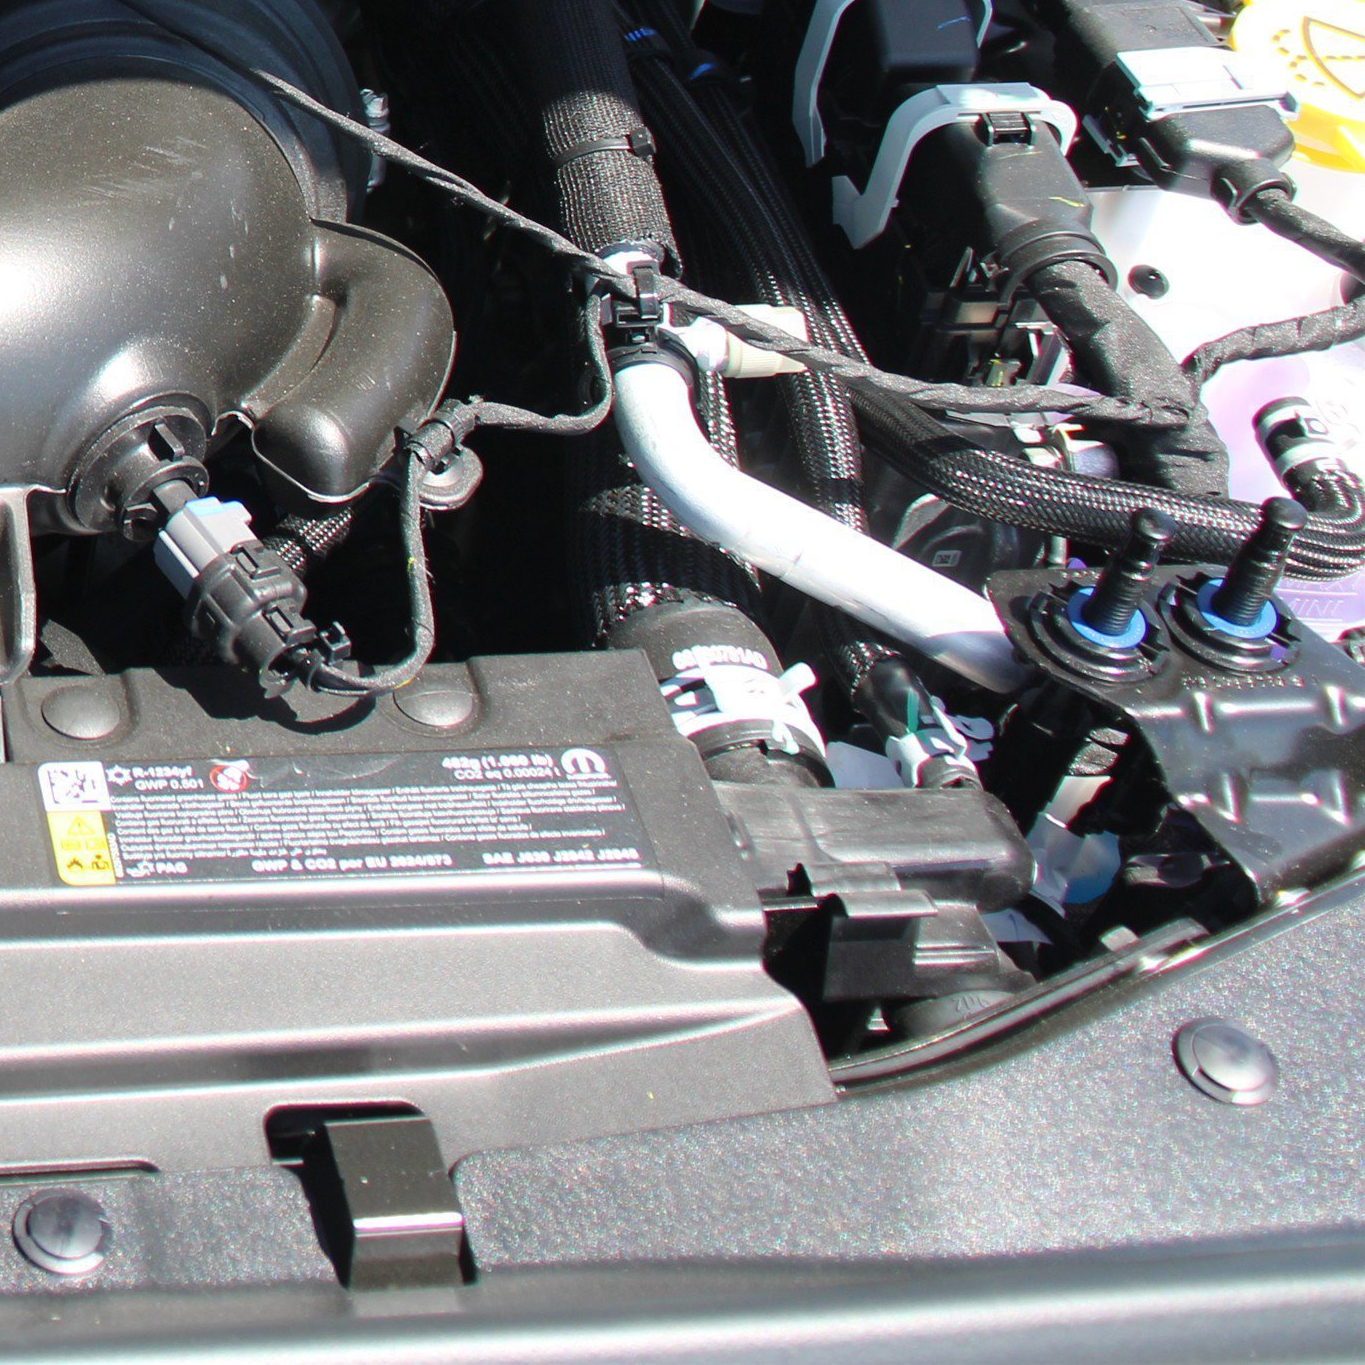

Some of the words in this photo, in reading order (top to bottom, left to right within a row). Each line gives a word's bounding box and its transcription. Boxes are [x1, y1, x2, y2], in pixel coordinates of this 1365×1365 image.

[132, 766, 193, 780] R-1234yf
[454, 769, 483, 780] CO2
[135, 779, 168, 791] GWP
[252, 859, 288, 872] GWP
[304, 857, 337, 870] CO2
[364, 856, 388, 869] EU
[482, 852, 515, 864] SAE
[156, 861, 188, 875] PAG
